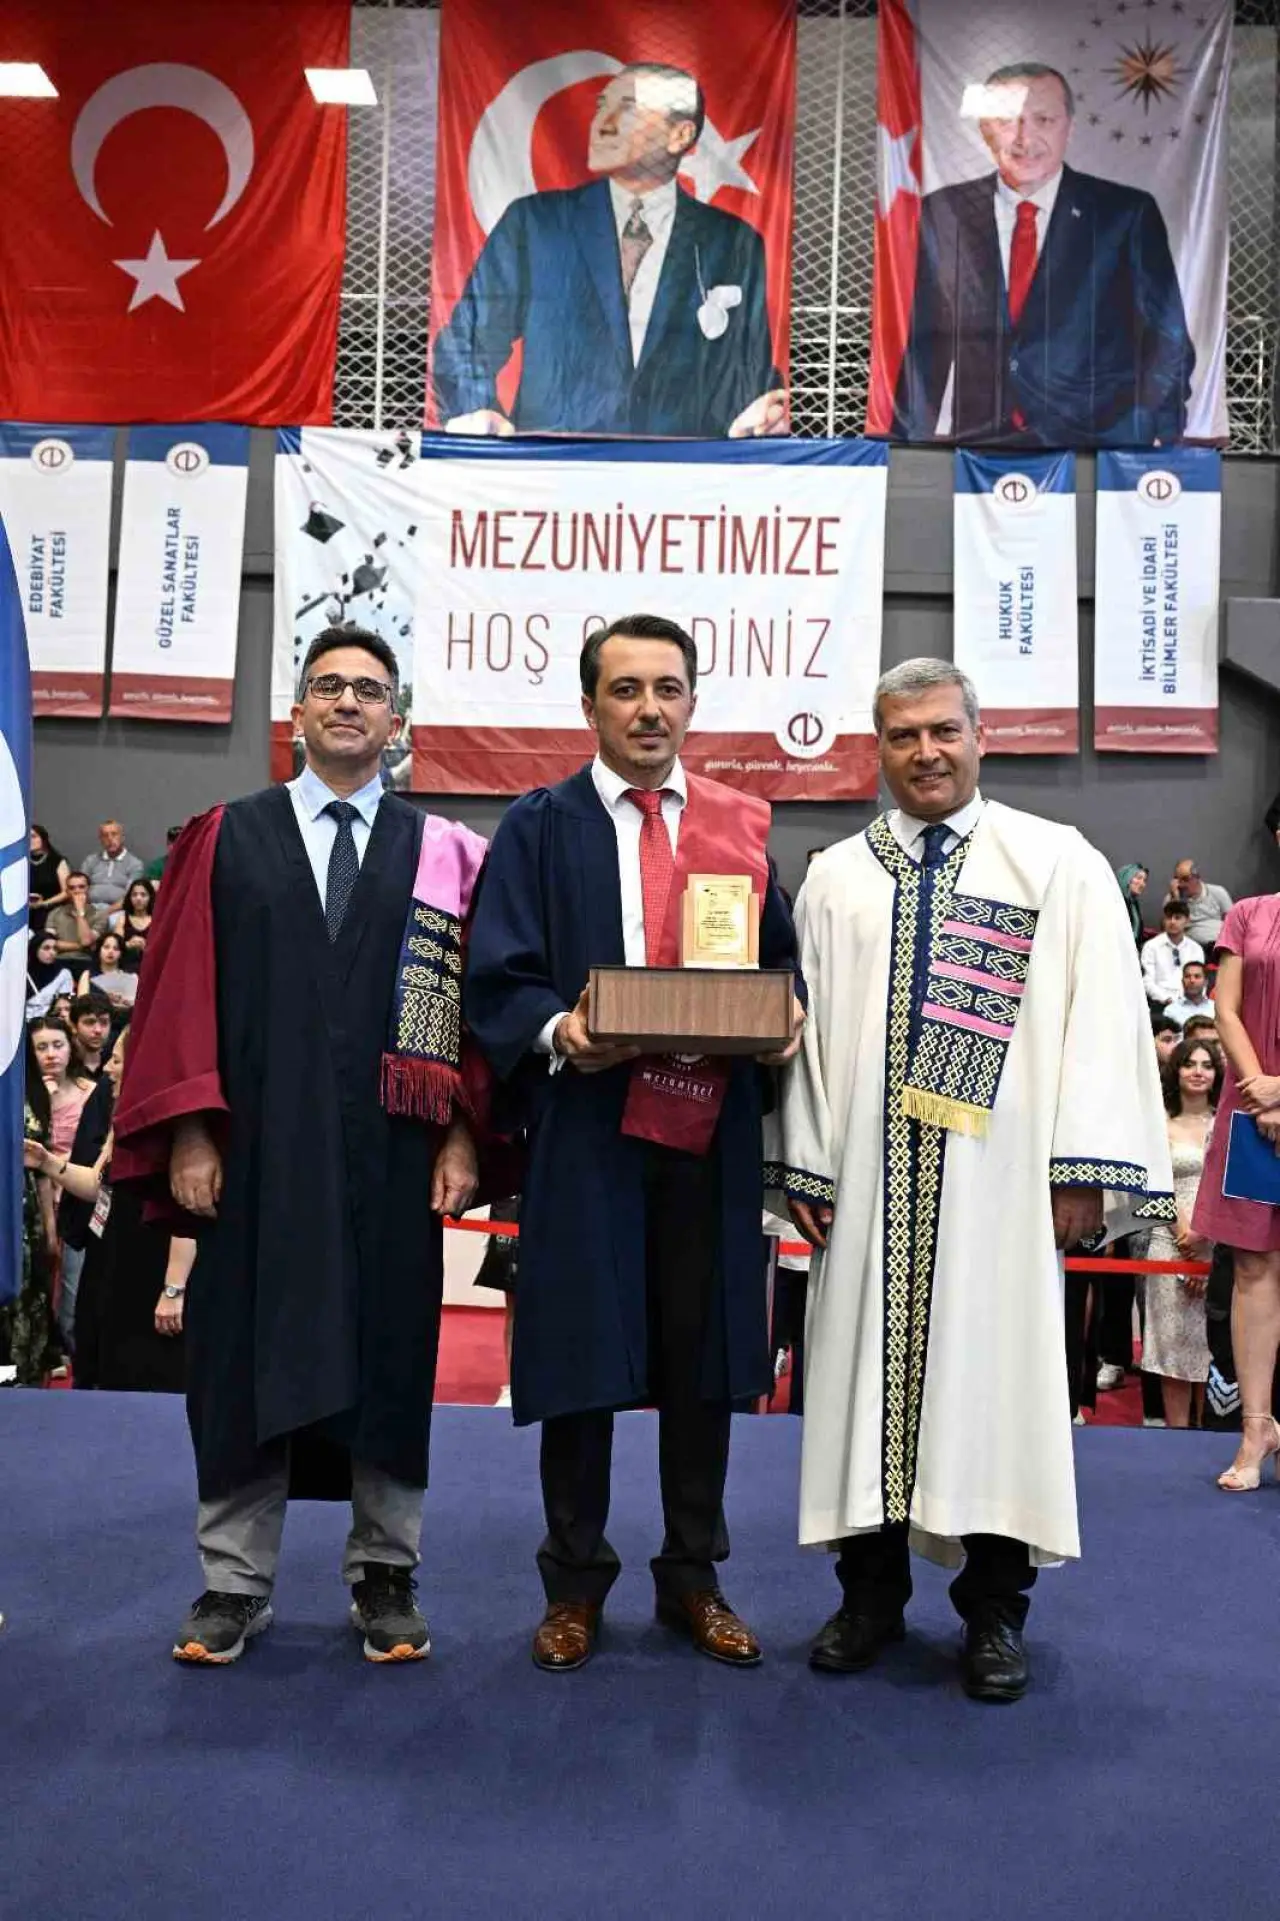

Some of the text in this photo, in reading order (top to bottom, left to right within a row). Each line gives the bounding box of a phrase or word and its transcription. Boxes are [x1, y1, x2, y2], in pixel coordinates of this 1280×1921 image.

[28, 534, 46, 613] EDEBİYAT
[48, 531, 67, 618] FAKÜLTESİ
[156, 507, 181, 649] GÜZEL SANATLAR
[180, 534, 200, 623] FAKÜLTESİ
[450, 502, 841, 576] MEZUNİYETİMİZE
[999, 580, 1013, 640] HUKUK
[1017, 566, 1034, 655] FAKÜLTESİ
[1142, 585, 1157, 605] VE
[1159, 523, 1179, 695] BİLİMLER FAKÜLTESİ
[447, 607, 831, 685] HOŞ DİNİZ
